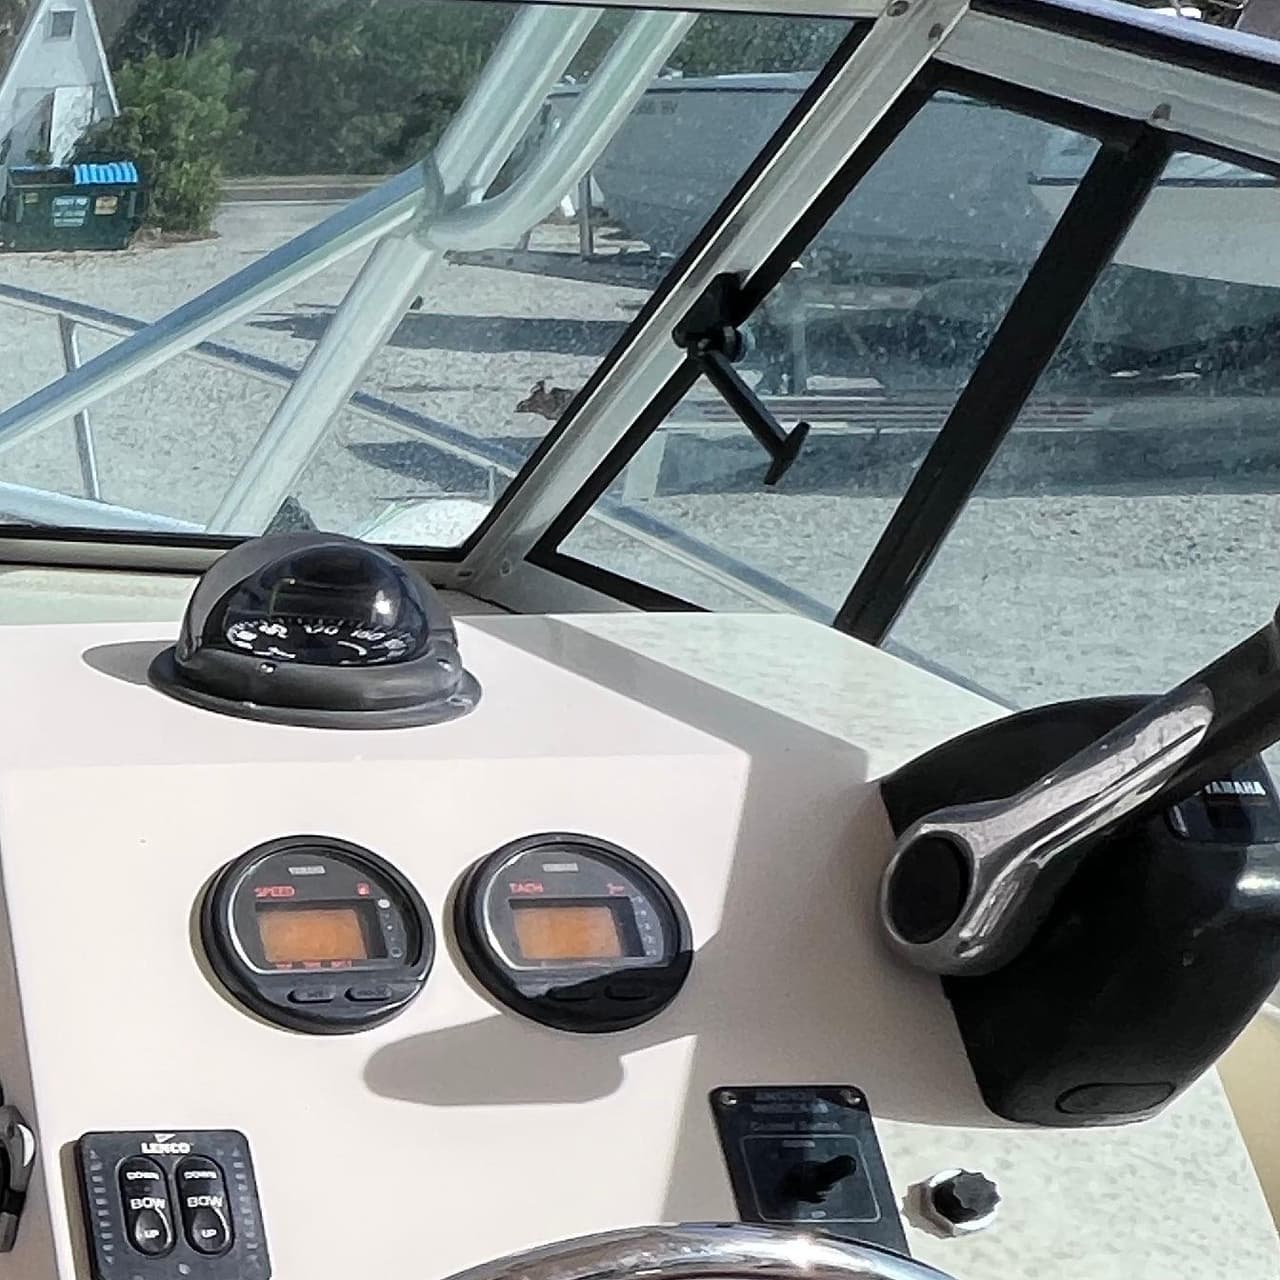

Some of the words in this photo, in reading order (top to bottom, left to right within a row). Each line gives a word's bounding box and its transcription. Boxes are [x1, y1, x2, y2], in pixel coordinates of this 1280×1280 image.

[254, 886, 295, 897] SPEED
[141, 1142, 191, 1154] LENCO
[130, 1197, 165, 1210] BOW
[187, 1196, 223, 1208] BOW
[144, 1229, 160, 1238] UP
[201, 1229, 217, 1238] UP
